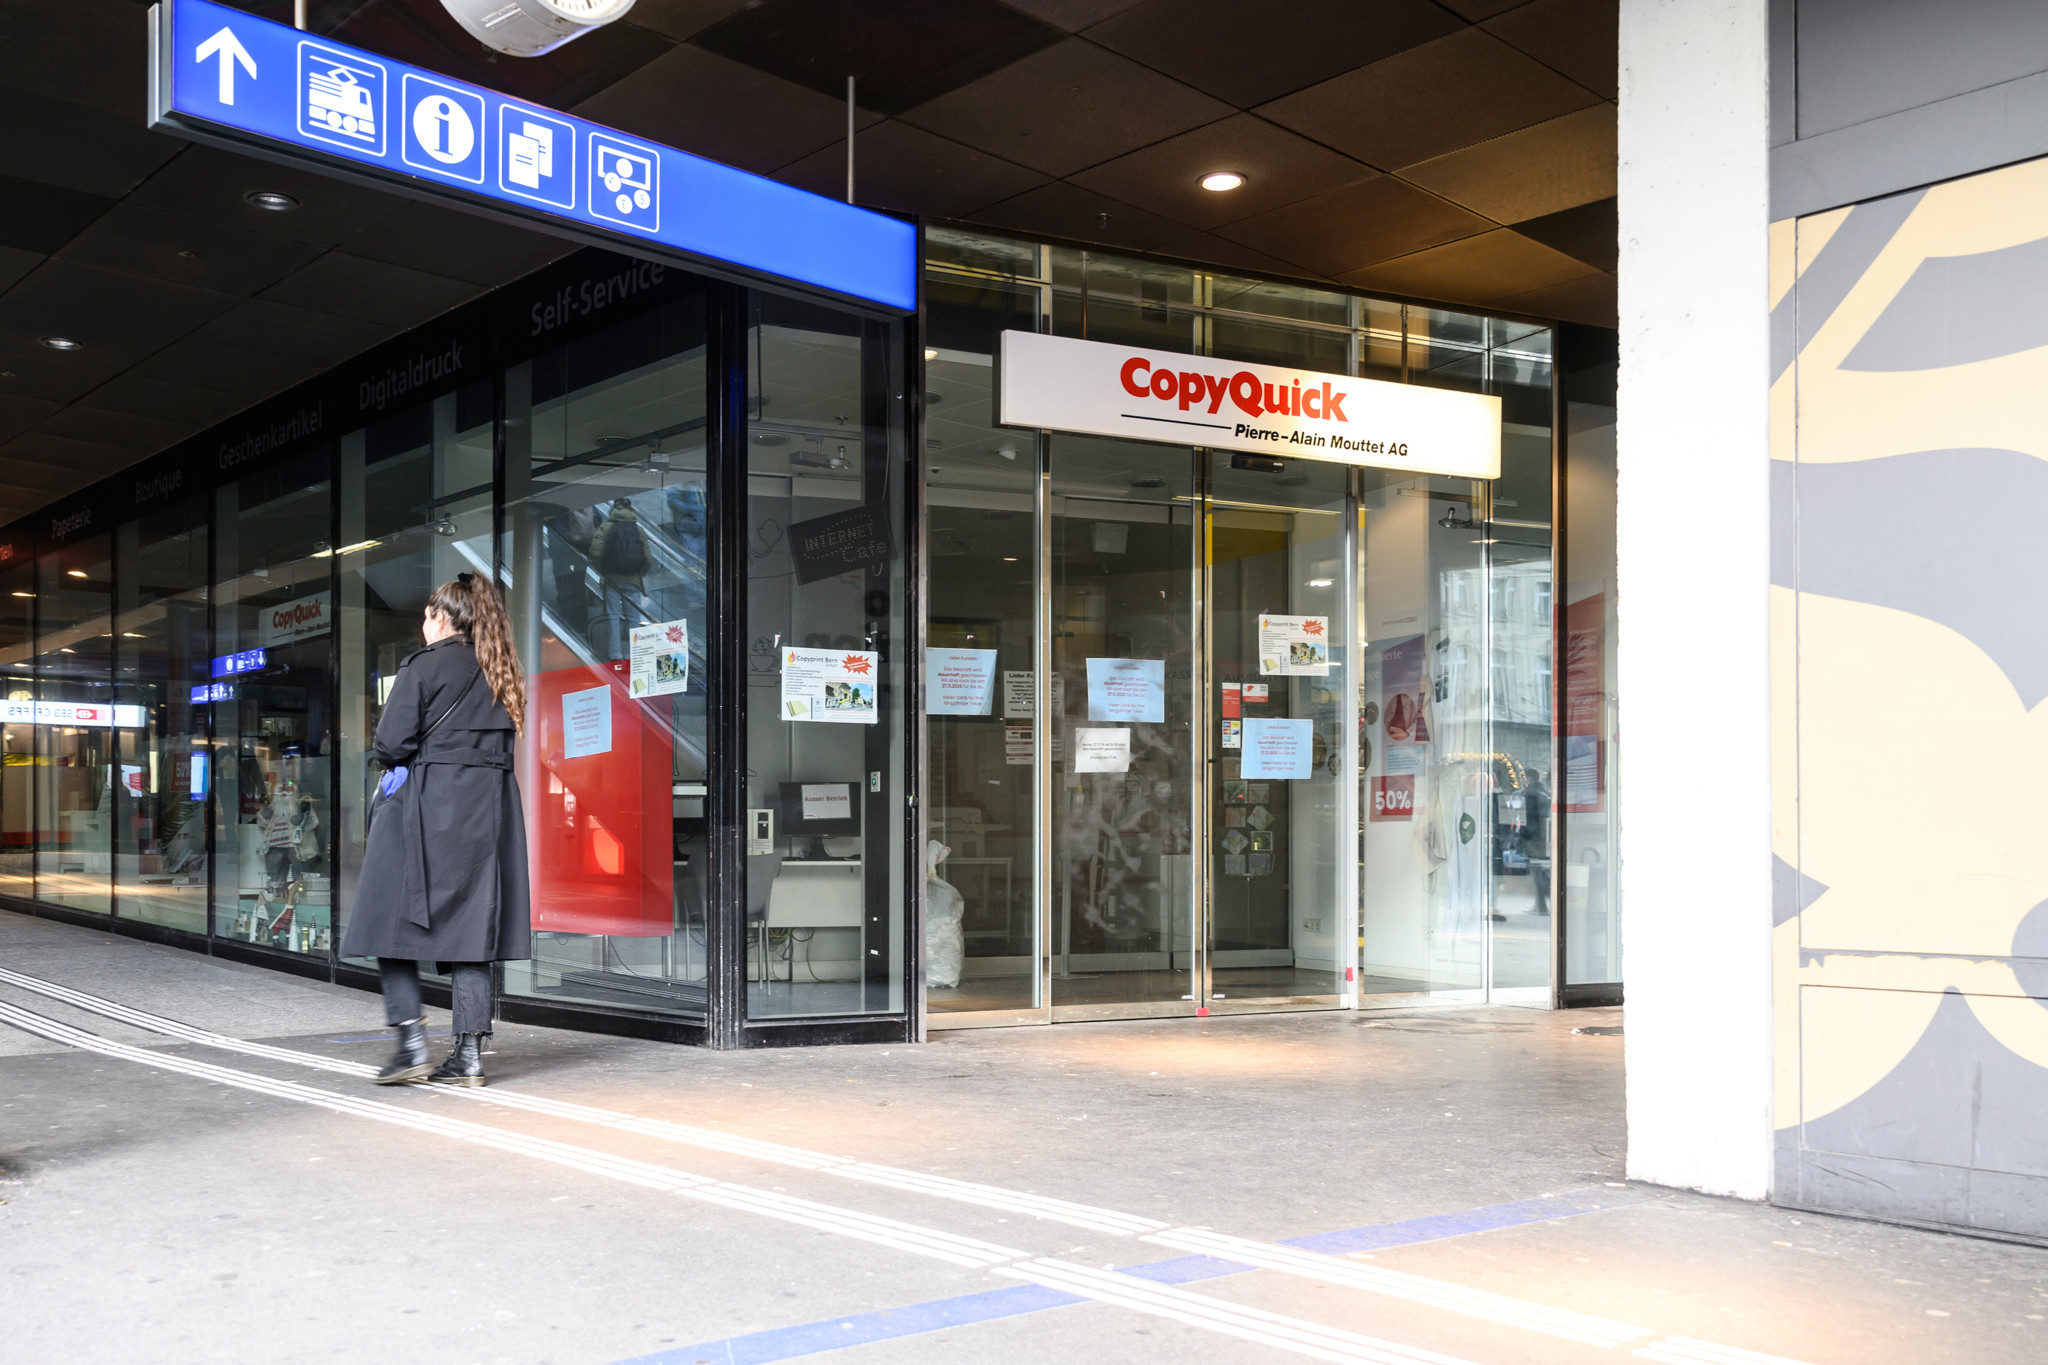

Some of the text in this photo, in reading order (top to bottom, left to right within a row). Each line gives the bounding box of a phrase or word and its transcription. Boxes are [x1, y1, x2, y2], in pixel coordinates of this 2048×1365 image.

[531, 259, 664, 336] Self-Service
[359, 338, 463, 411] Digitaldruck
[1120, 357, 1349, 422] CopyQuick
[218, 400, 323, 470] Geschenkartikel
[1331, 435, 1385, 453] Mouttet
[1388, 442, 1409, 457] AG
[135, 469, 183, 504] Boutique
[51, 504, 93, 540] Papeterie
[803, 523, 874, 552] INTERNET
[273, 598, 322, 630] CopyQuick
[796, 655, 824, 663] Copyprint
[1375, 789, 1411, 811] 50%
